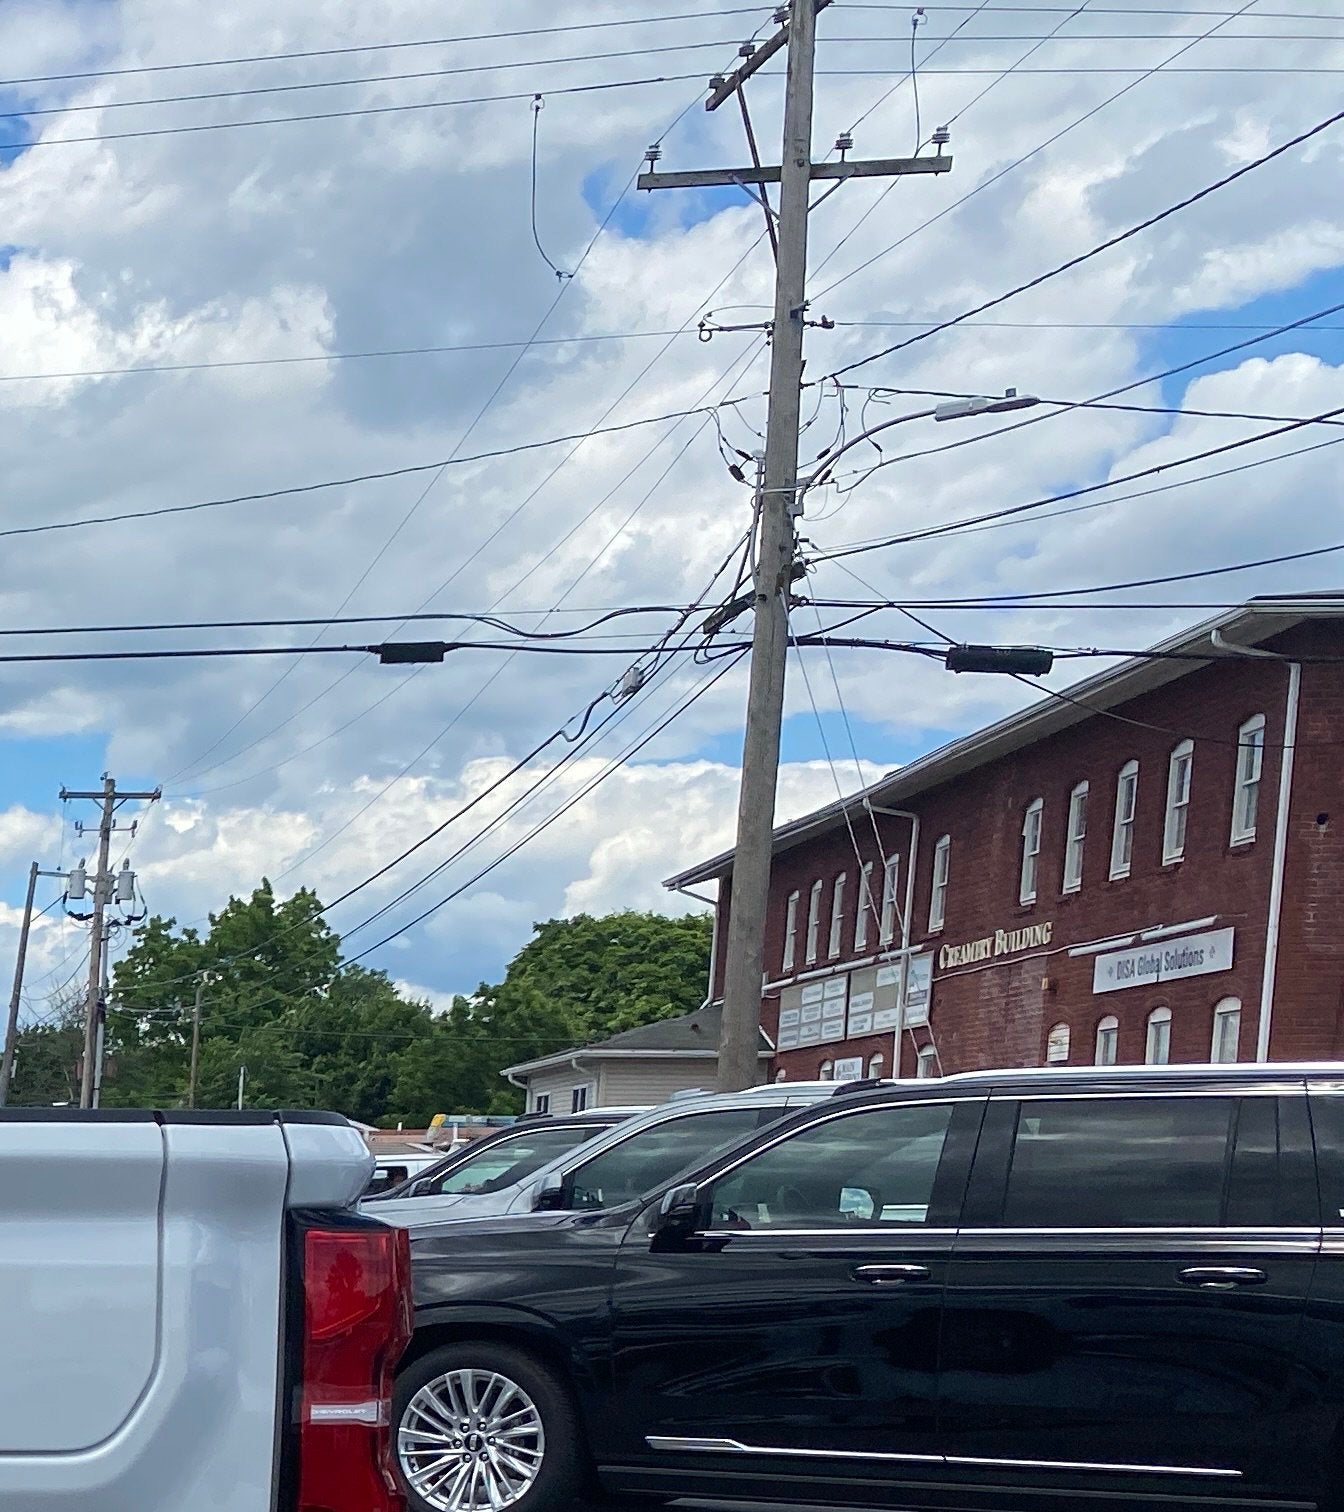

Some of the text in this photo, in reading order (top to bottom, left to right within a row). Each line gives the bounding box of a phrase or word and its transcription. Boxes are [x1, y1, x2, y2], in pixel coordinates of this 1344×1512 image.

[1116, 946, 1205, 980] DISA Global Solutions
